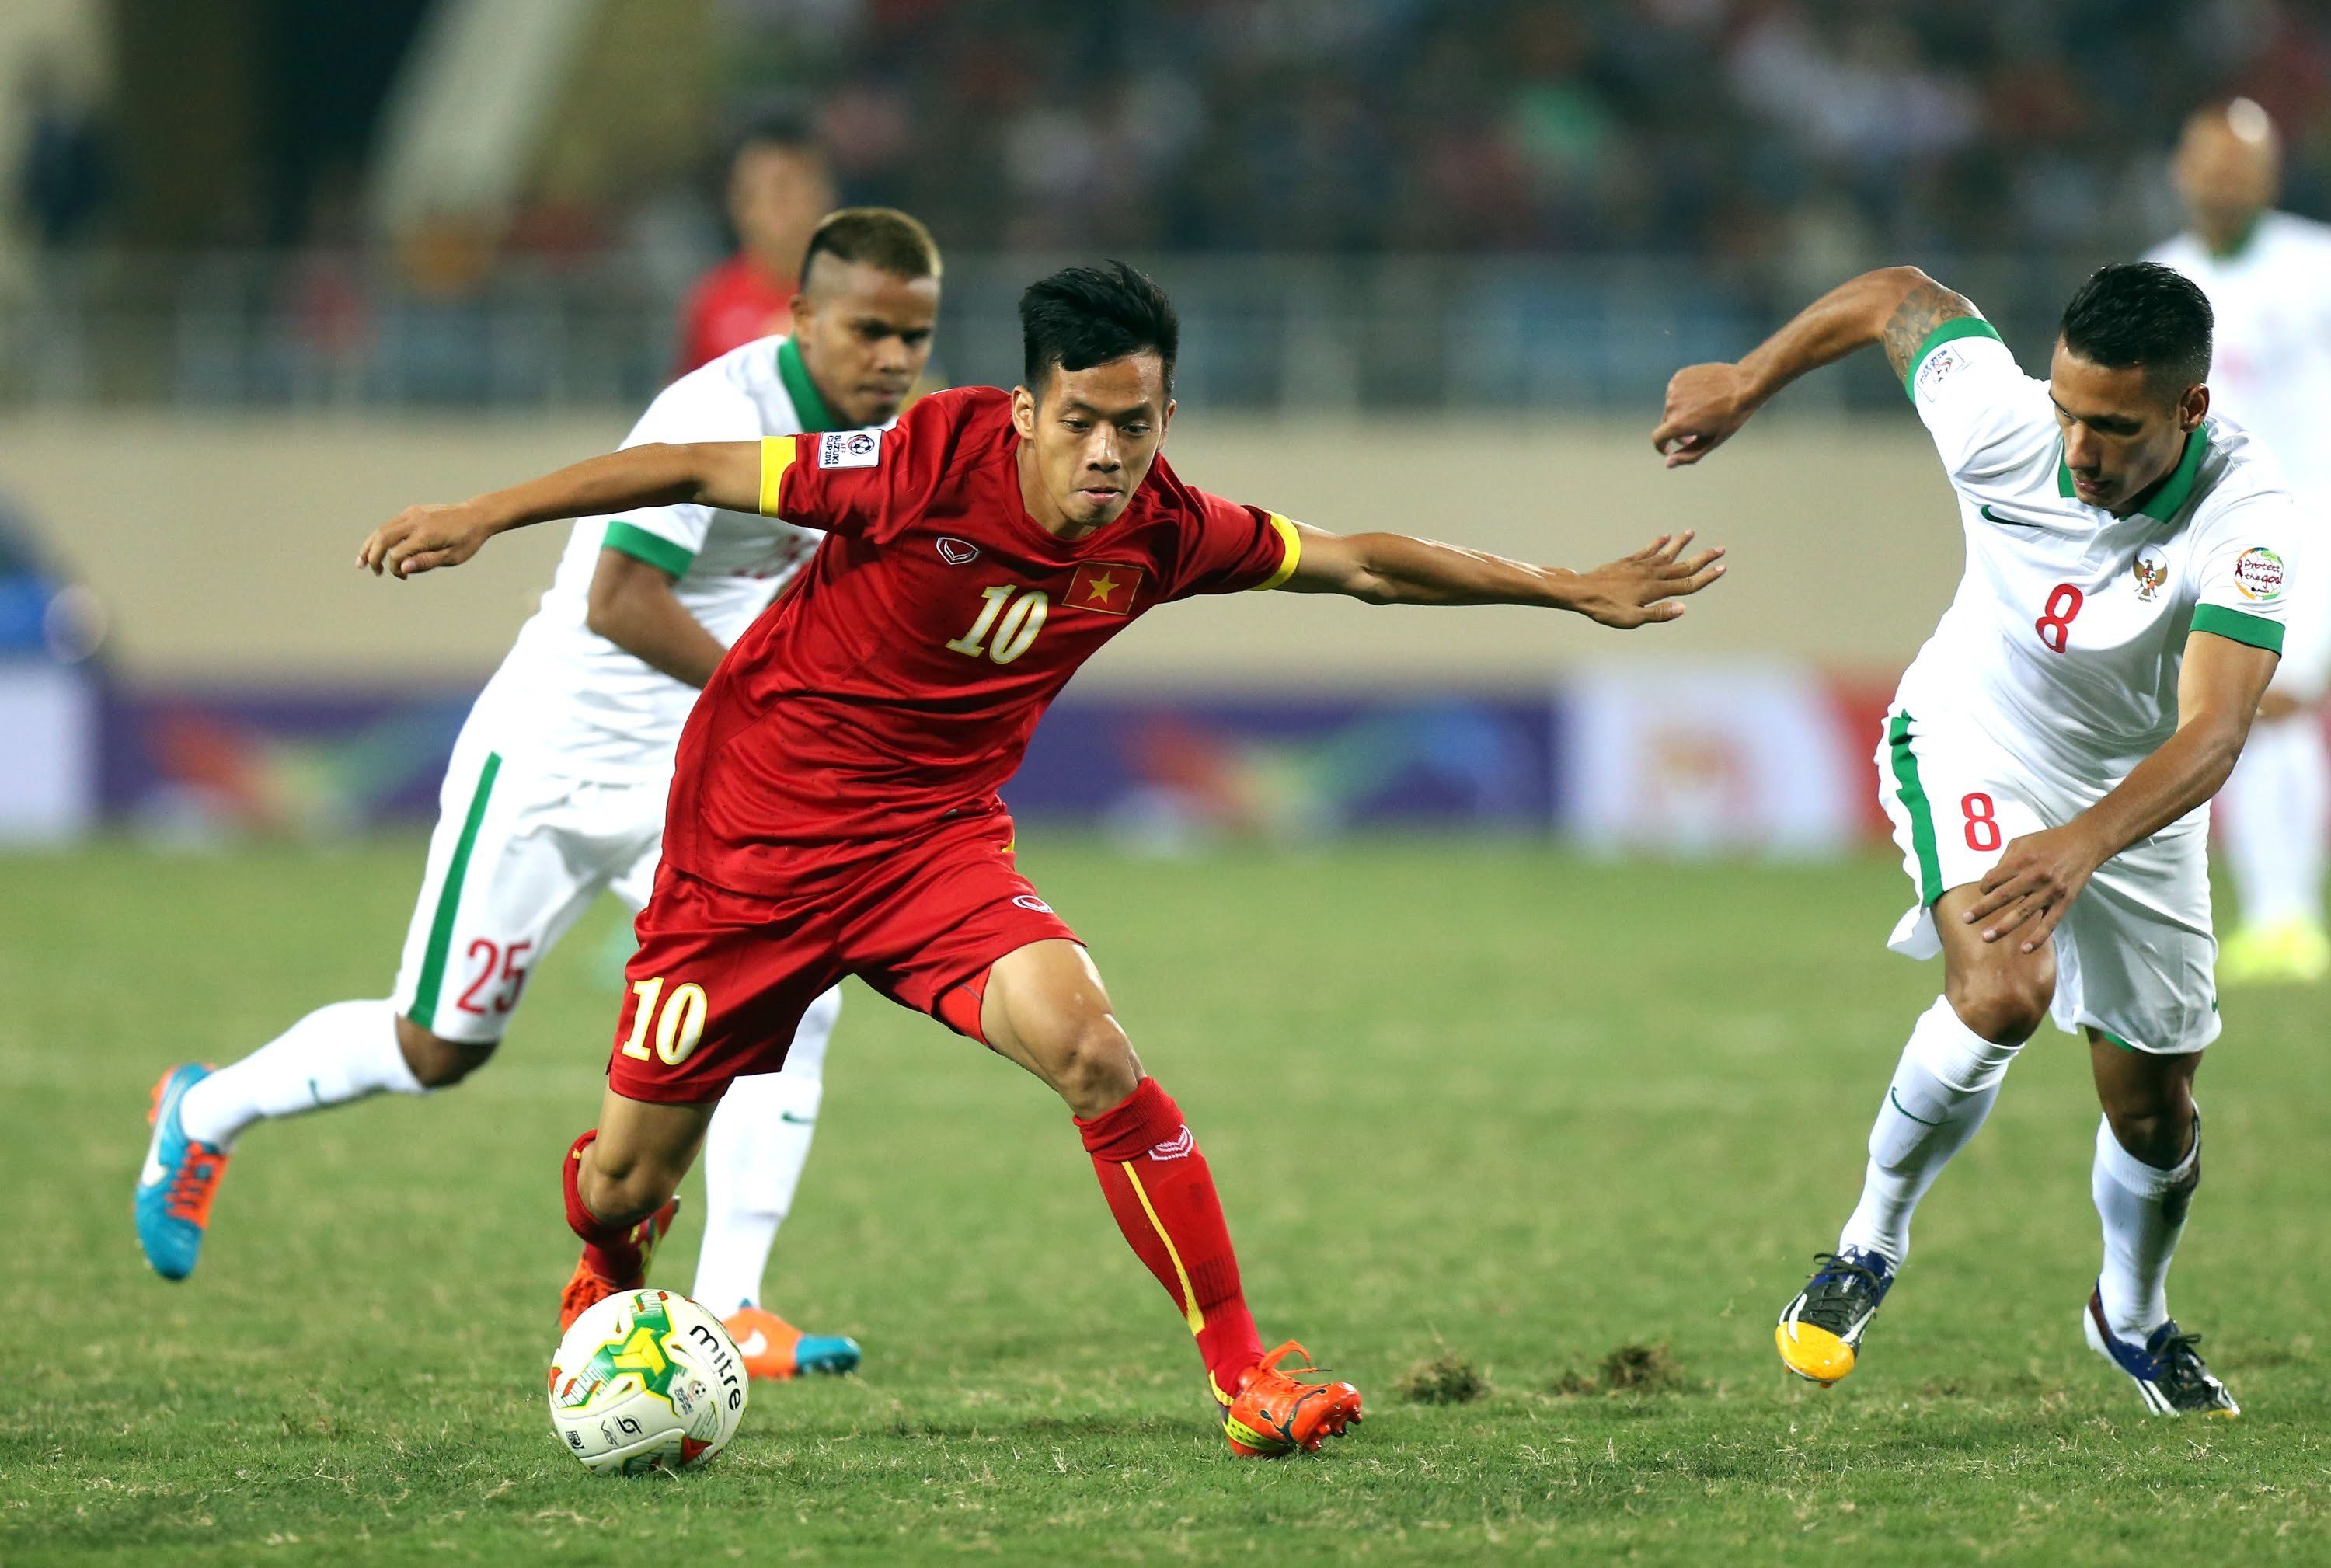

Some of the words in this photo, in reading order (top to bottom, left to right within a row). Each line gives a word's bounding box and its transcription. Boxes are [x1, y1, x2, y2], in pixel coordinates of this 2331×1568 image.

[832, 435, 841, 464] SUZUKI
[2244, 559, 2280, 573] Protect
[945, 584, 1048, 664] 10
[2035, 583, 2084, 653] 8
[1960, 793, 2002, 852] 8
[456, 938, 532, 1014] 25
[622, 976, 708, 1065] 10
[689, 1325, 741, 1410] mitre
